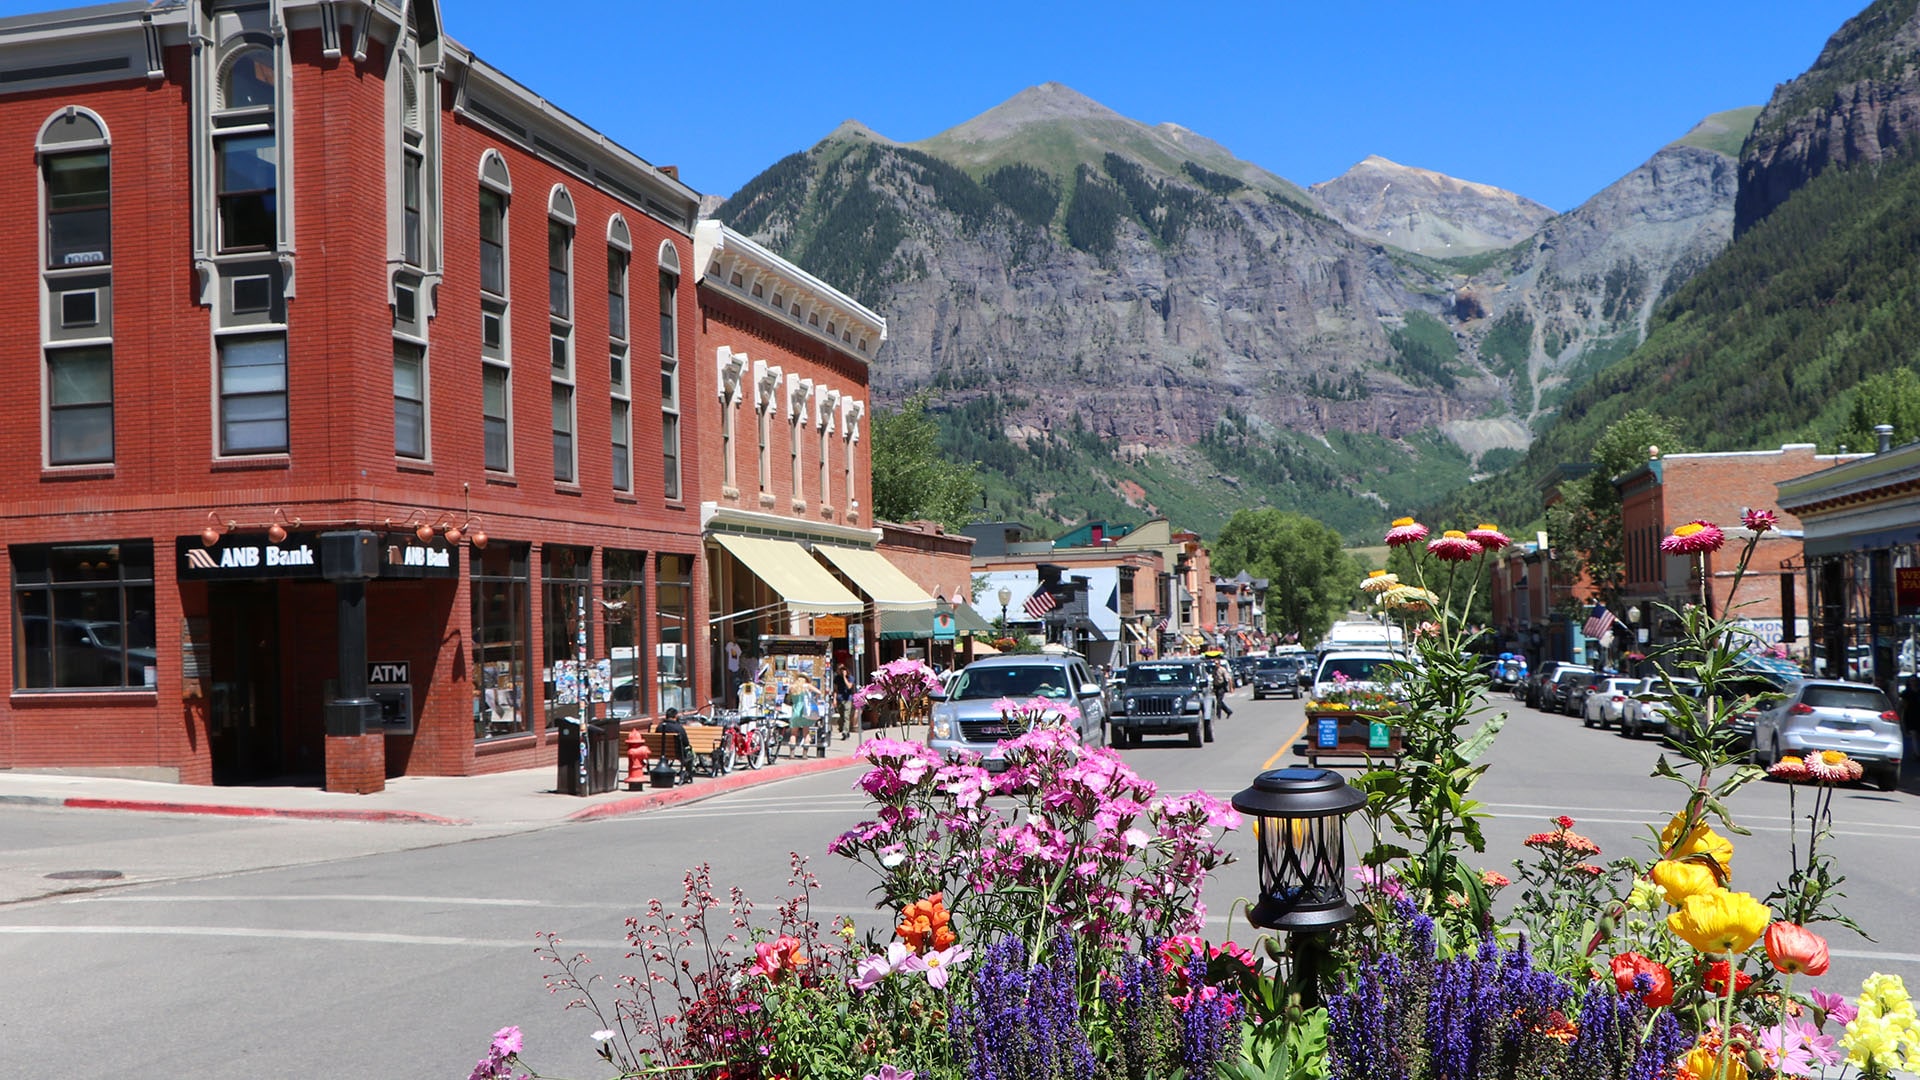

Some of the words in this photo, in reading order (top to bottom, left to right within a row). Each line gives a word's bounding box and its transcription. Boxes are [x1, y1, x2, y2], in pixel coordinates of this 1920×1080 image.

[220, 547, 260, 568] ANB
[266, 544, 314, 566] Bank
[404, 546, 425, 566] ANB
[426, 547, 450, 567] Bank
[370, 664, 406, 682] ATM
[981, 726, 1008, 734] GMC
